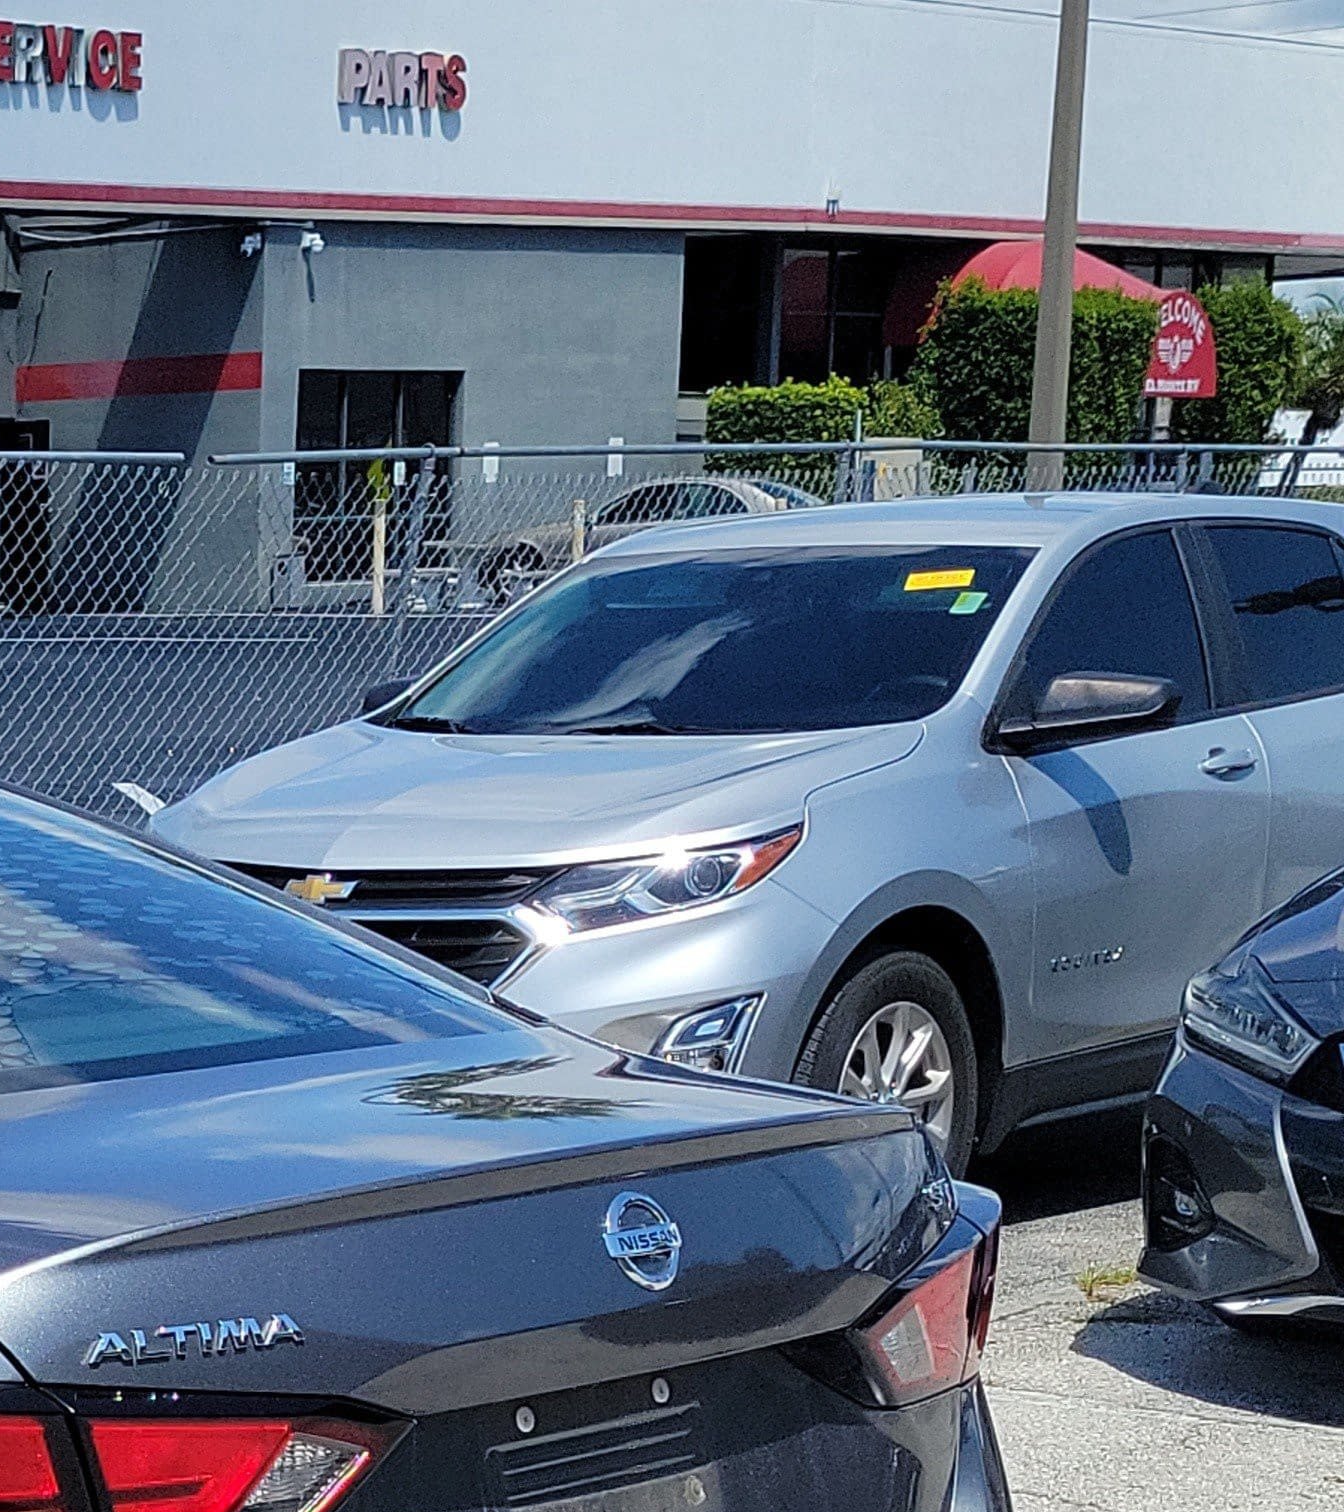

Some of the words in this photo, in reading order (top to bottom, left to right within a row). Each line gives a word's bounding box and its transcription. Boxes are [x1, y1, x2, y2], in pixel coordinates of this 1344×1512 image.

[337, 48, 467, 111] PARTS
[1157, 297, 1206, 346] ELCOME
[617, 1229, 678, 1252] NISSAN
[80, 1313, 306, 1367] ALTIMA
